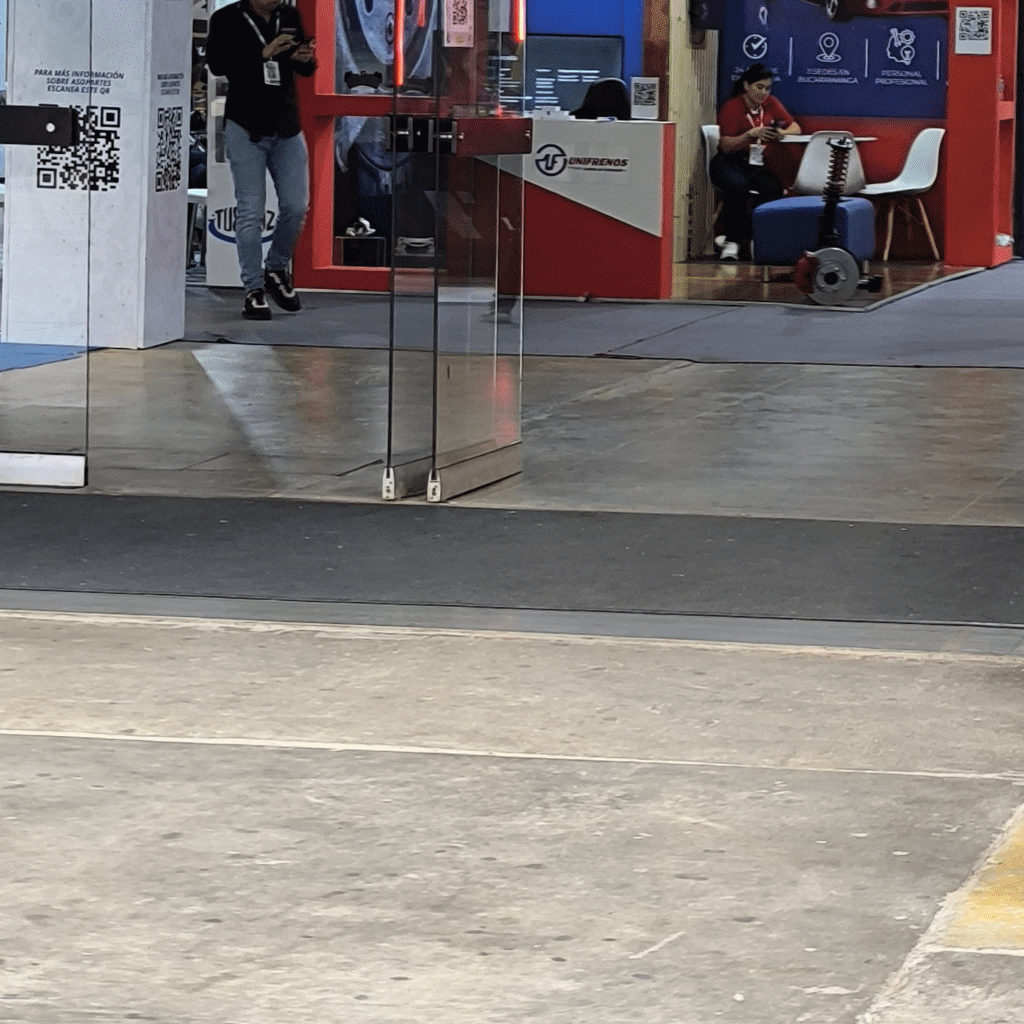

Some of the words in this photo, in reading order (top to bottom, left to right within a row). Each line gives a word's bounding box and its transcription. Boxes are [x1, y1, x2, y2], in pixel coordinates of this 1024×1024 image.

[34, 68, 53, 76] PARA
[54, 68, 70, 77] MÁS
[71, 70, 125, 80] INFORMACIÓN
[46, 77, 70, 85] SOBRE
[47, 85, 80, 93] ESCANEA
[81, 86, 98, 94] ESTE
[99, 87, 110, 96] QR
[568, 157, 629, 167] UNIFRENOS
